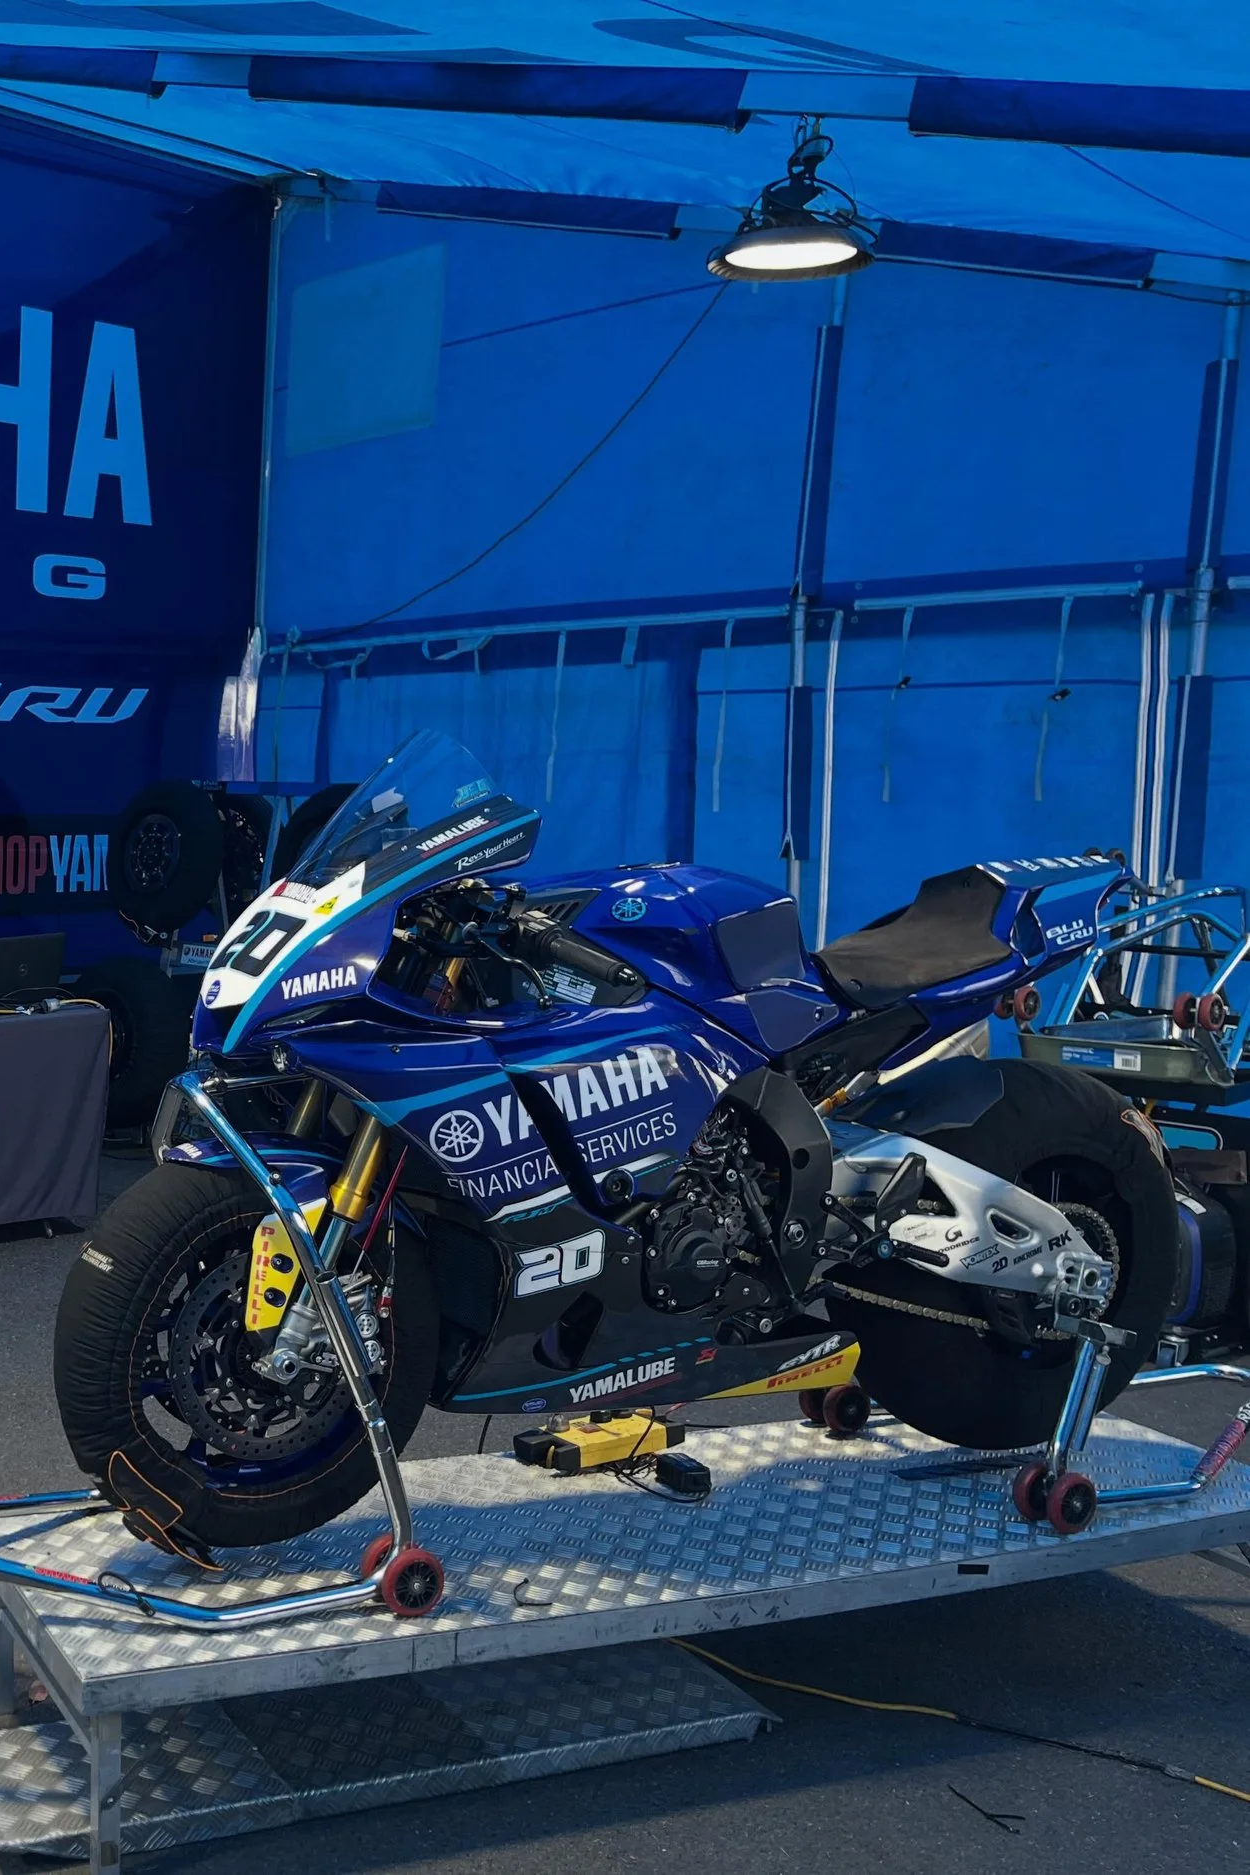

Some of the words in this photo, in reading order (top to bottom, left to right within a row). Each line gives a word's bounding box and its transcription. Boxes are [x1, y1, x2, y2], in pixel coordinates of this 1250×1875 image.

[416, 815, 489, 852] YAMALUBE
[454, 851, 484, 871] Revs
[482, 842, 502, 858] Your
[502, 832, 524, 847] Heart
[209, 910, 307, 977] 20
[1045, 919, 1084, 939] BLU
[1056, 926, 1094, 945] CRU
[281, 965, 357, 1000] YAMAHA
[1048, 1230, 1072, 1251] RK
[251, 1226, 276, 1326] PIRELLI
[514, 1229, 606, 1298] 20
[992, 1256, 1008, 1274] 2D
[776, 1334, 841, 1372] GYTR
[569, 1357, 676, 1403] YAMALUBE
